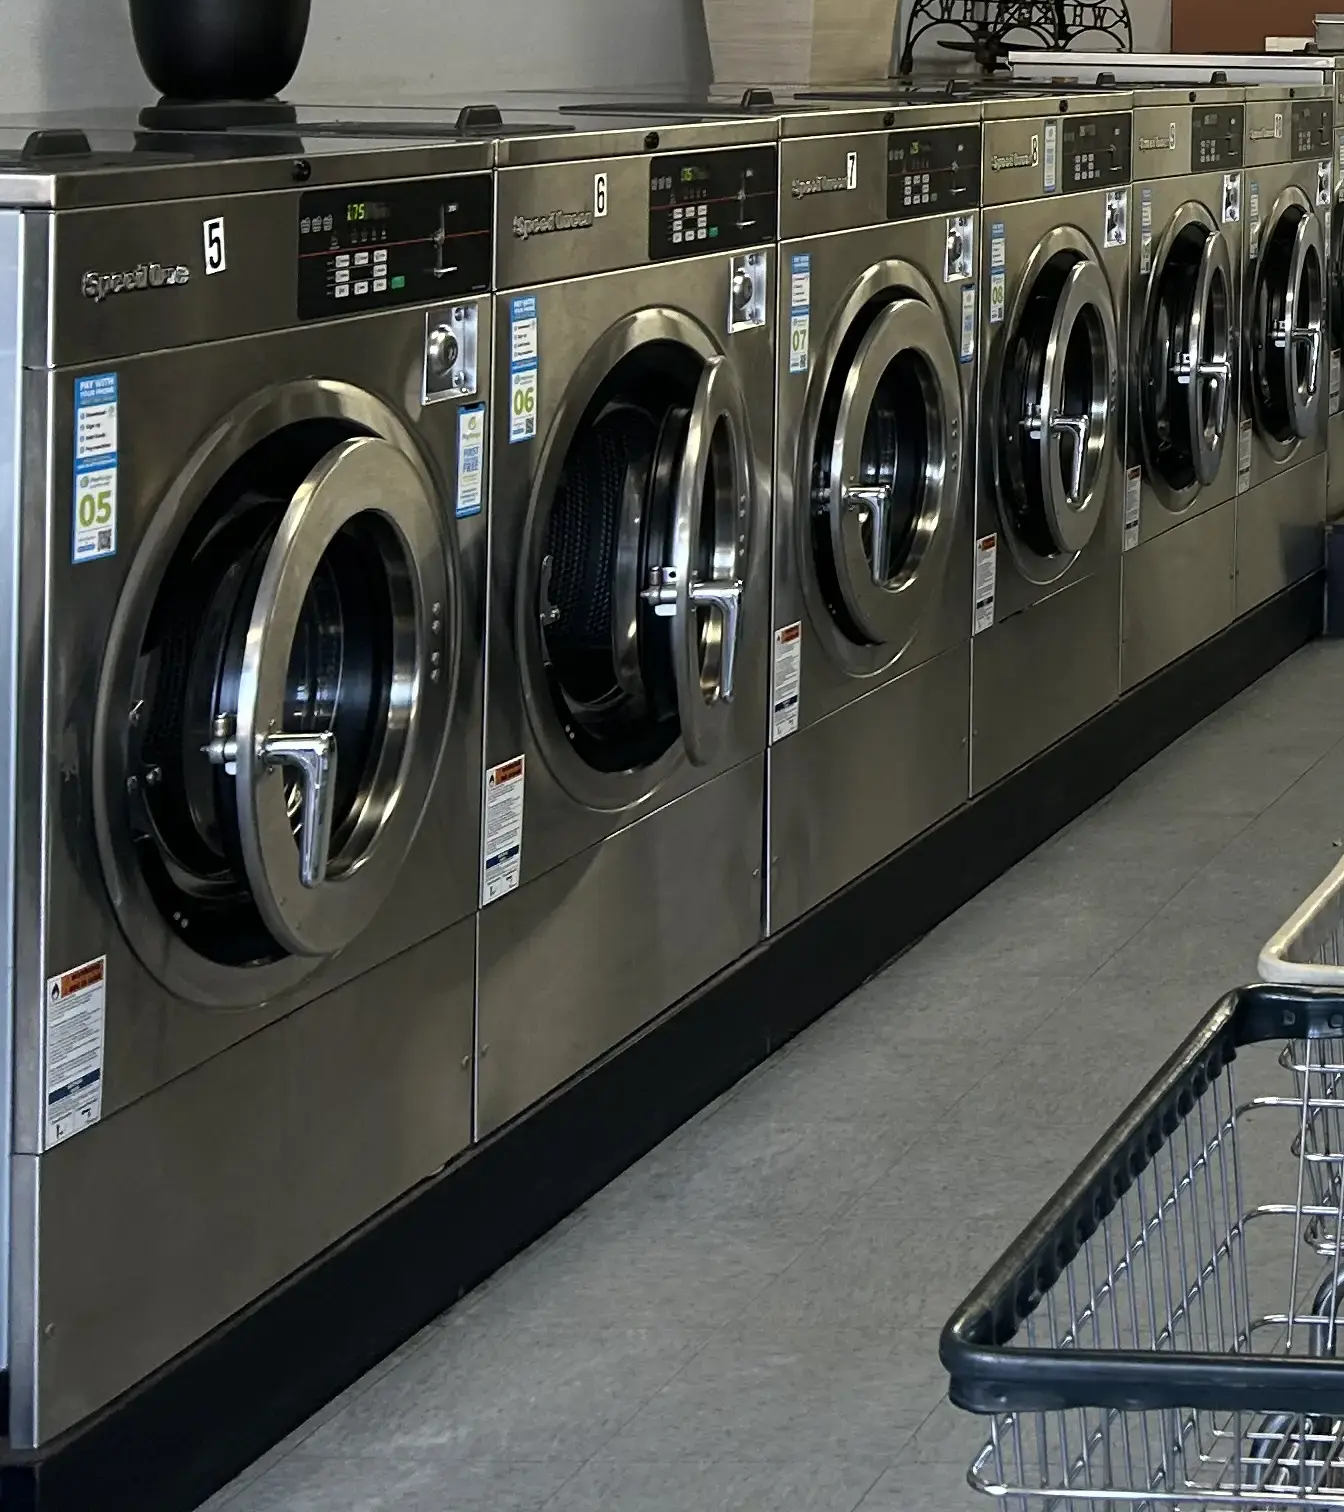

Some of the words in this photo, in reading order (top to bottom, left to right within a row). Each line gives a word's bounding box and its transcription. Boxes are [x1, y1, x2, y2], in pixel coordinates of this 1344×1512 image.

[849, 154, 855, 186] 7
[596, 176, 605, 214] 6
[207, 222, 221, 269] 5
[792, 329, 807, 351] 07
[513, 387, 534, 416] 06
[79, 490, 112, 528] 05
